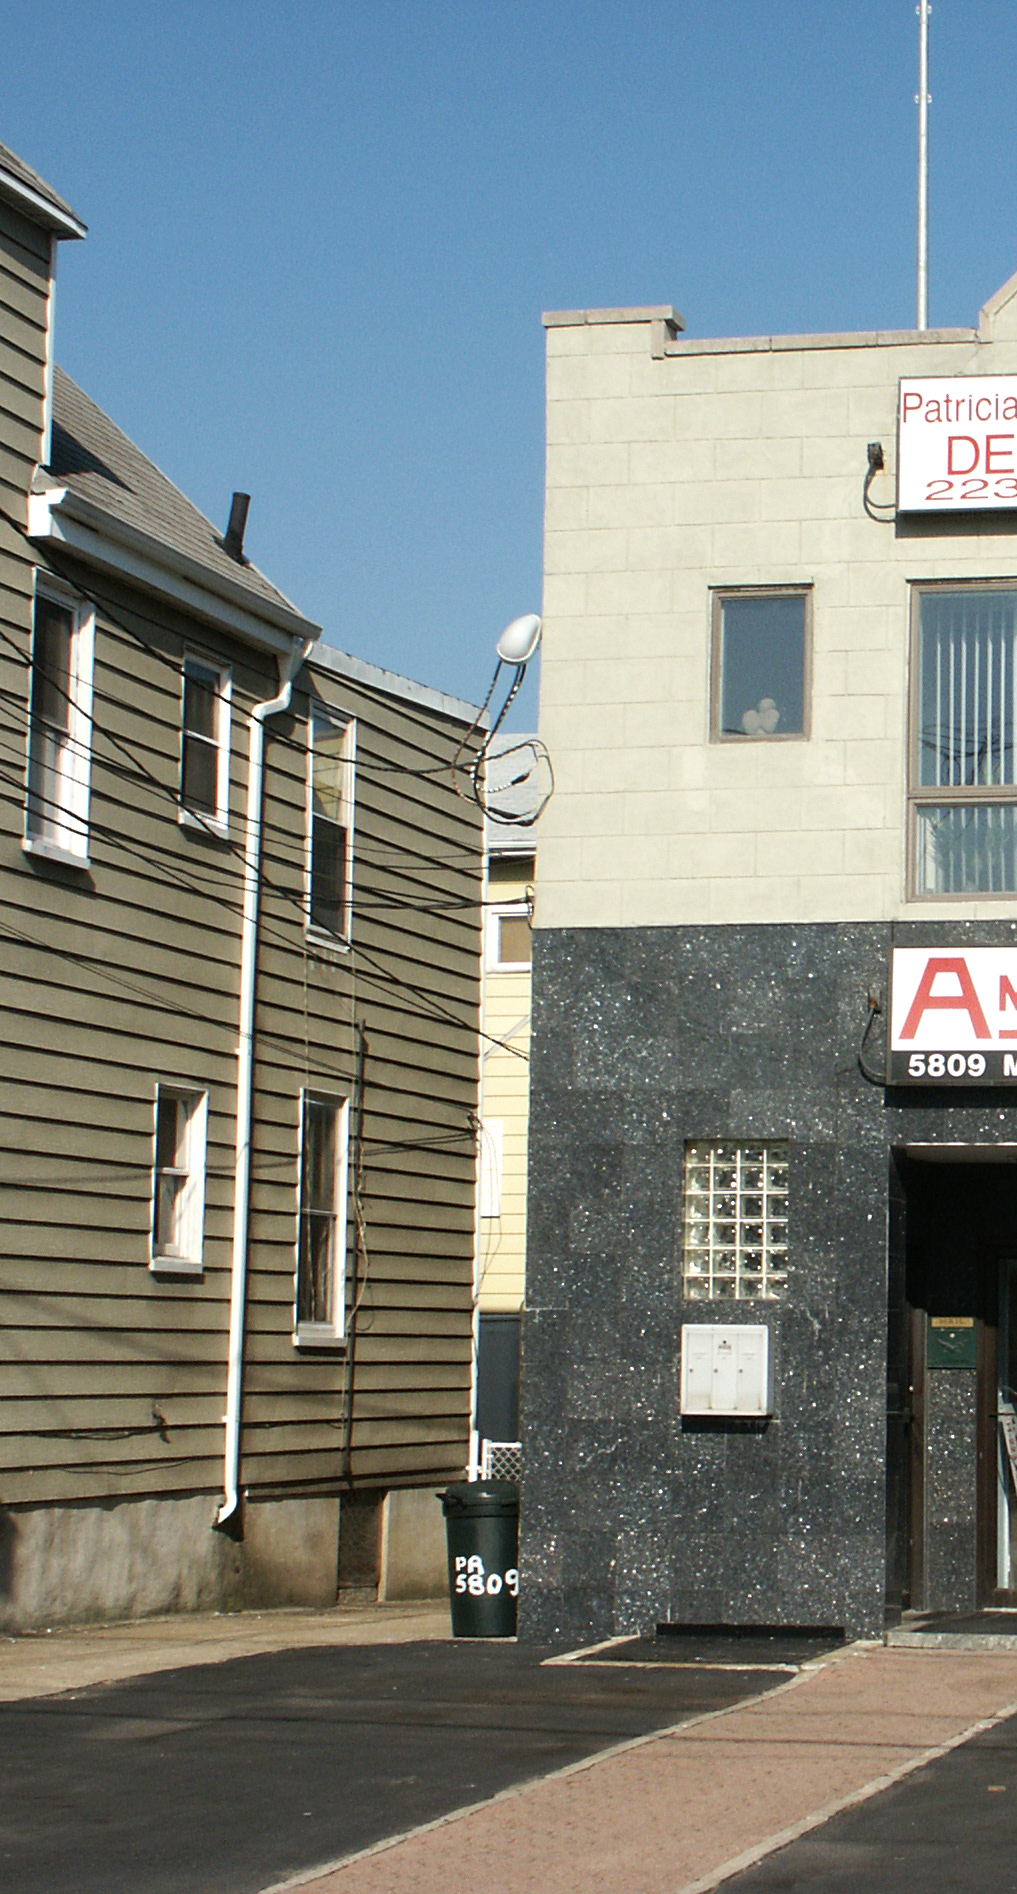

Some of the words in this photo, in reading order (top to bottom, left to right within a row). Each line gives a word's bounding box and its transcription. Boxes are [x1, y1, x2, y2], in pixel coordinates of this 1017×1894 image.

[908, 1053, 987, 1077] 5809
[455, 1555, 485, 1575] PA
[455, 1568, 519, 1597] 5809
